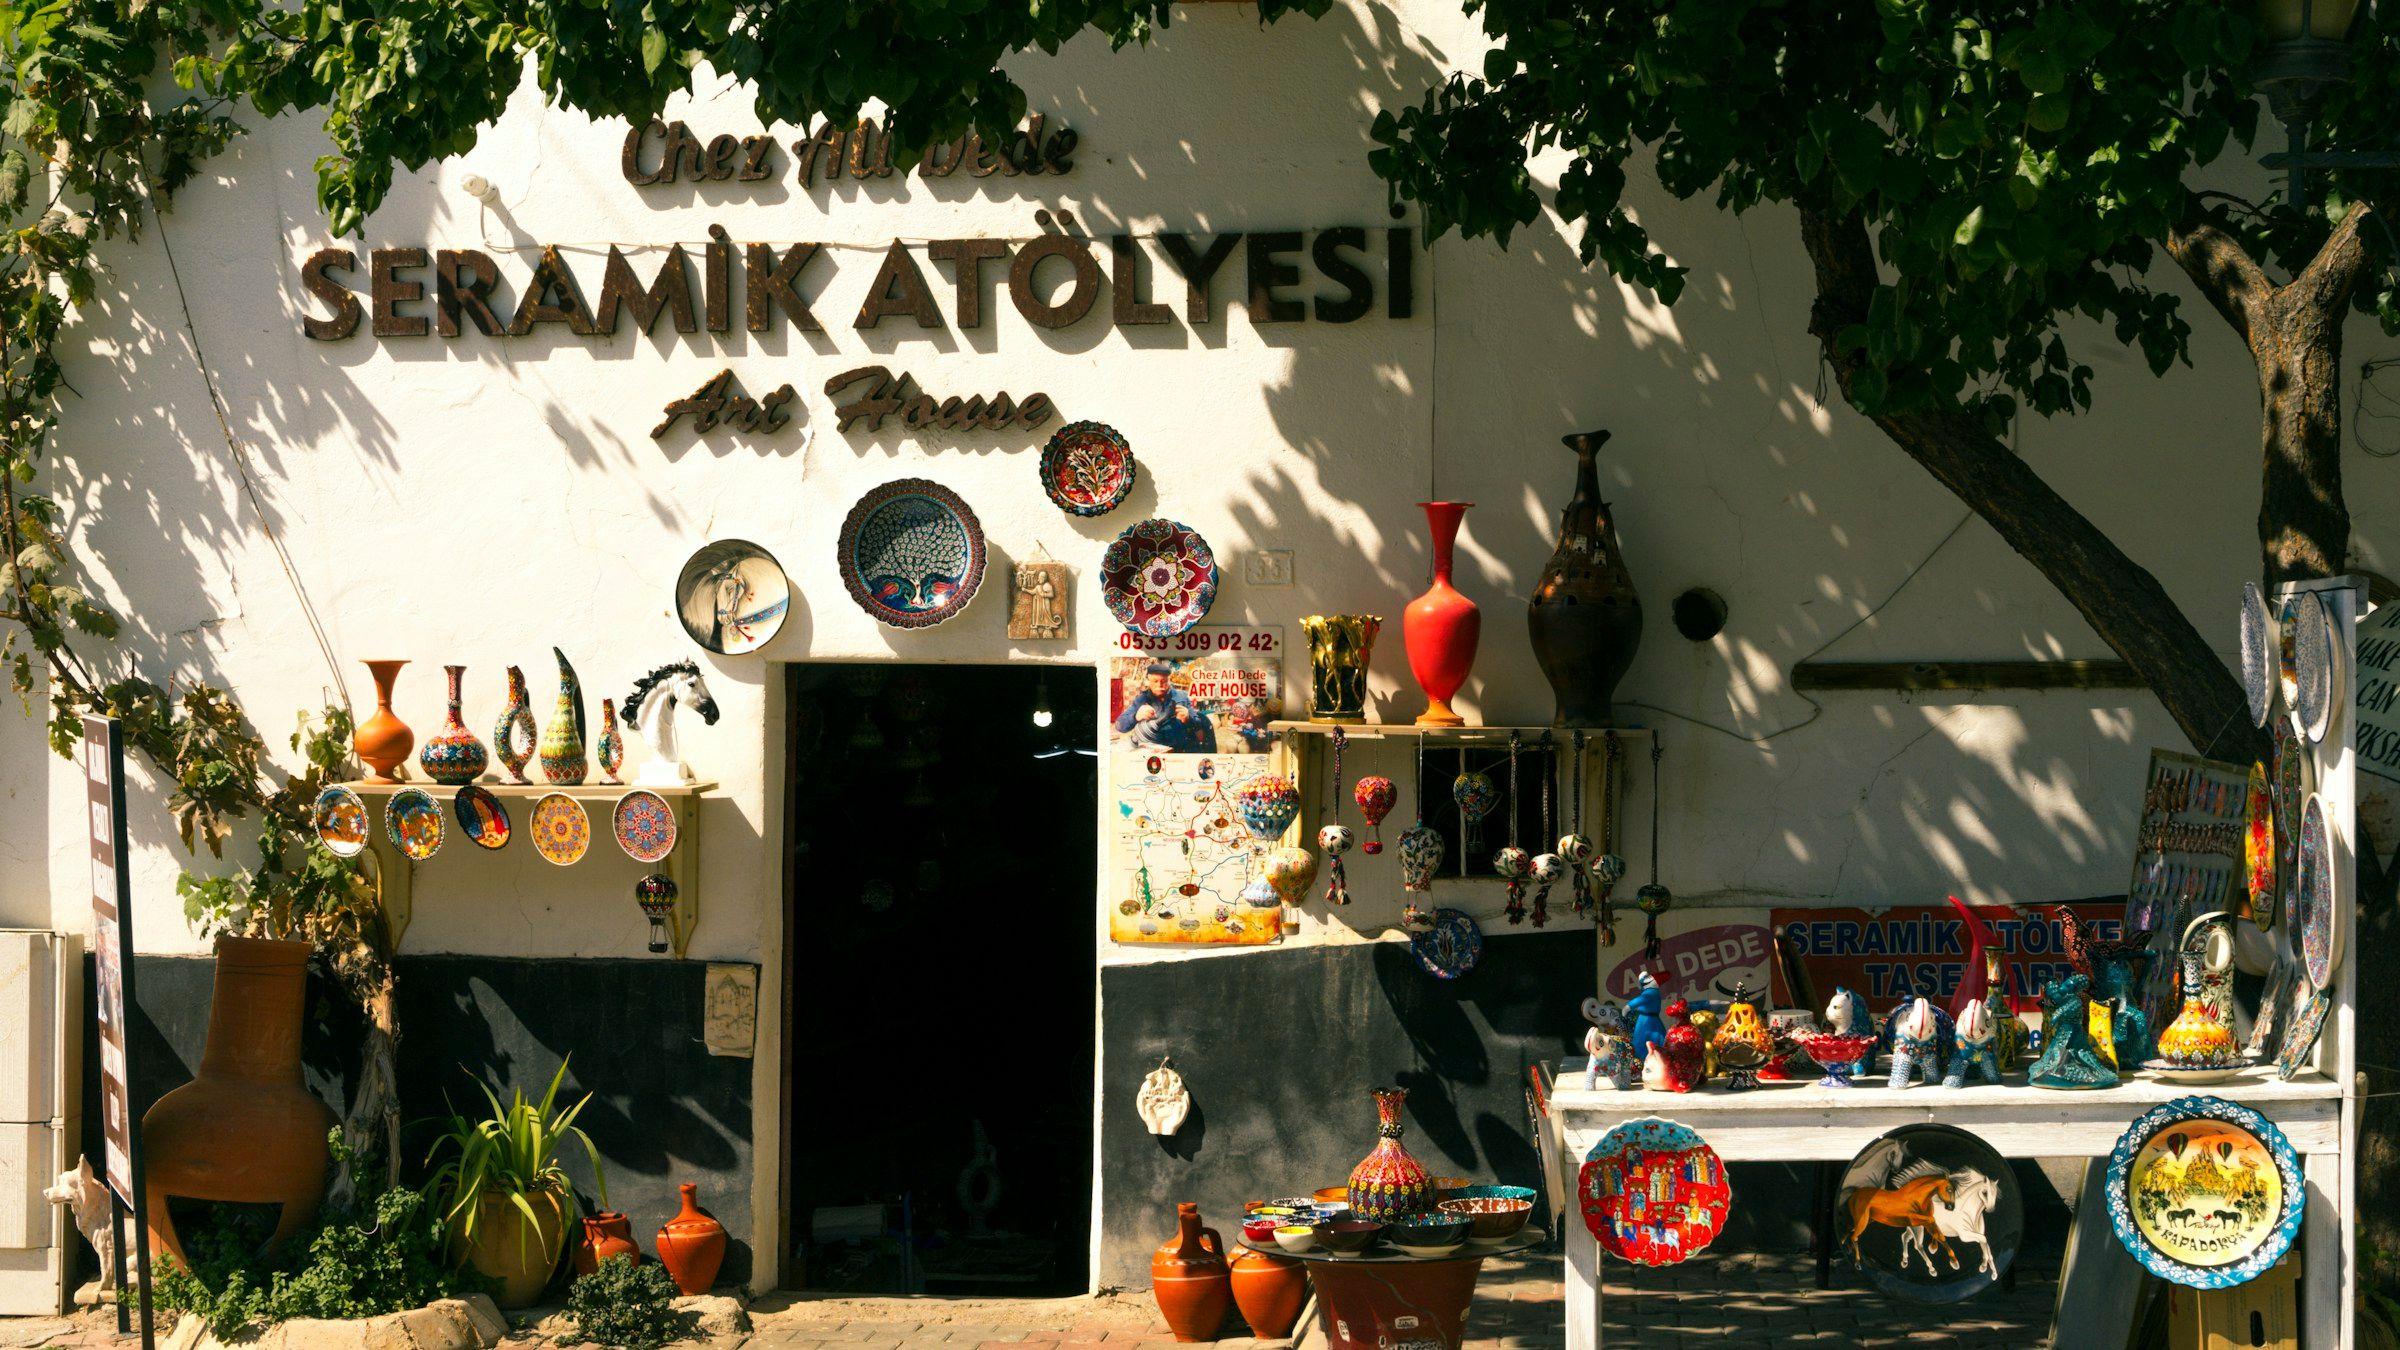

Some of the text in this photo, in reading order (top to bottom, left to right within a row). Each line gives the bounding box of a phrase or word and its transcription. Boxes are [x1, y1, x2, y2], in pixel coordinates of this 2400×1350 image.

[622, 117, 775, 186] Chez
[302, 202, 1413, 341] SERAMİK ATÖLYESİ
[824, 365, 1053, 433] House
[1120, 632, 1273, 651] 0533 309 02 42
[1189, 682, 1267, 697] ART HOUSE
[1192, 669, 1267, 680] Chez Ali Dede
[1675, 931, 1764, 977] DEDE
[1786, 912, 1964, 956] SERAMİK
[2160, 1229, 2247, 1252] KAPADOKYA
